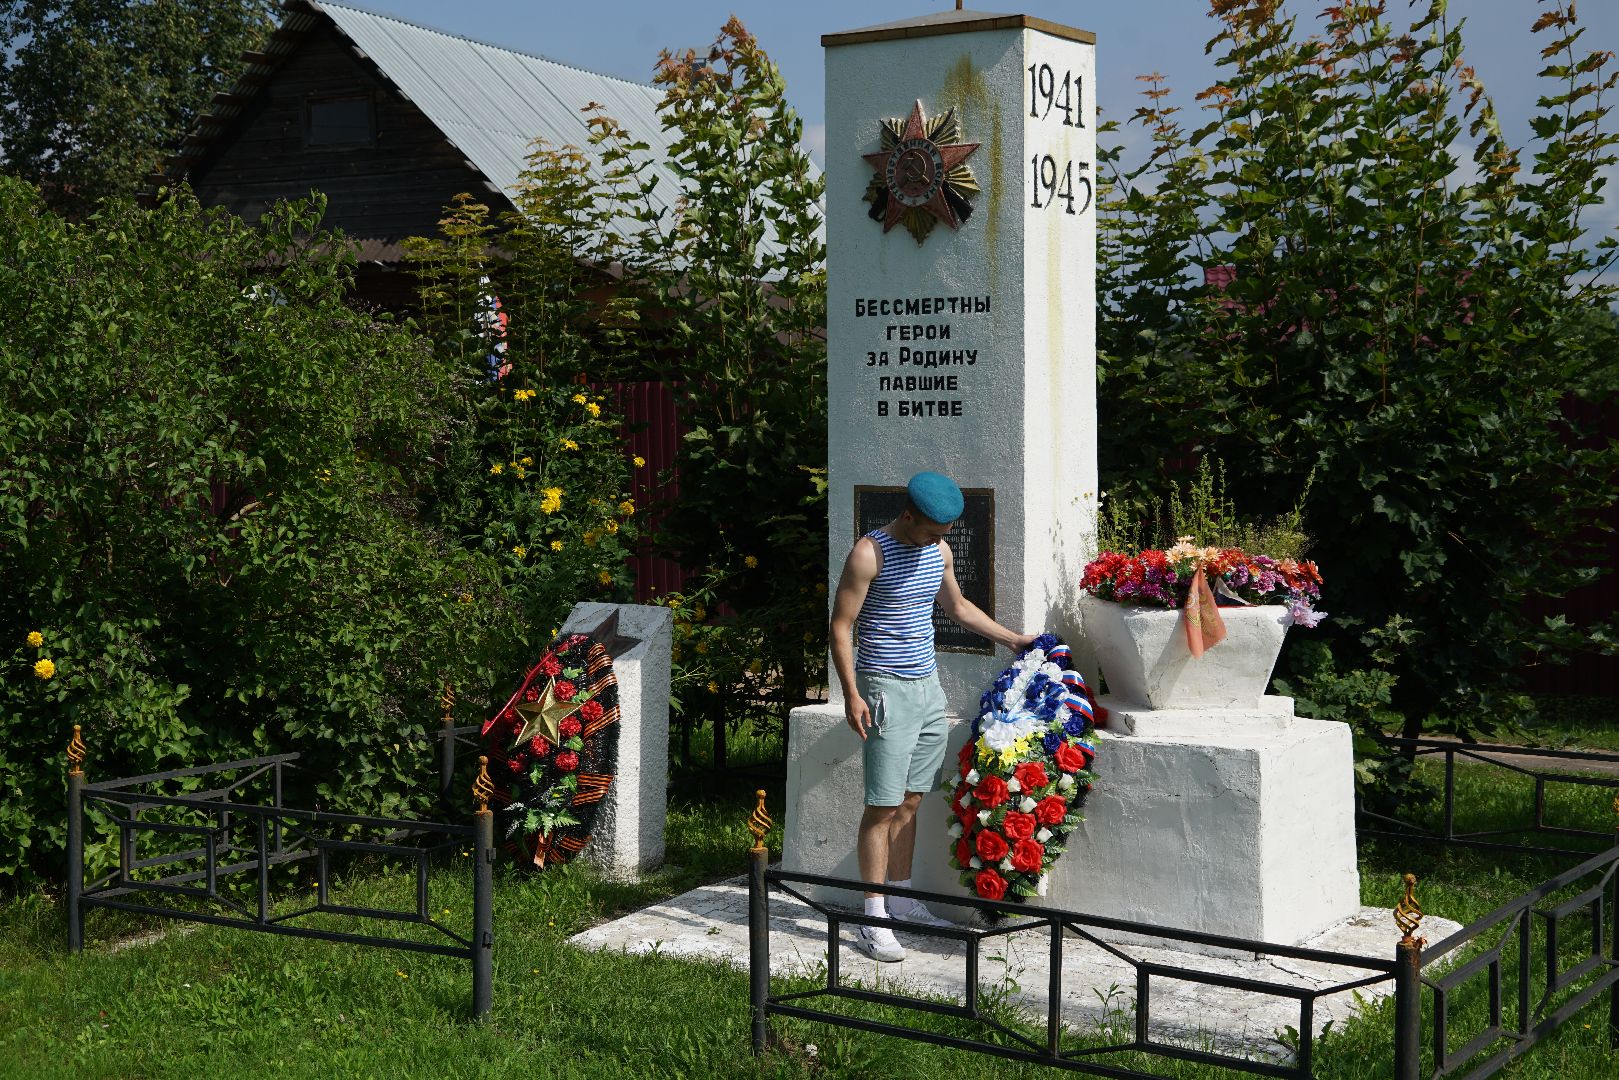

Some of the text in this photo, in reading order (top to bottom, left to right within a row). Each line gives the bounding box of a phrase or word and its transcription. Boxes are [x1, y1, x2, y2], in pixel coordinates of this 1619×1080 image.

[1028, 63, 1085, 128] 1941
[1031, 153, 1092, 216] 1945
[855, 296, 991, 317] БЕССМЕРТНЫ
[886, 325, 951, 341] ГЕРОИ
[866, 351, 889, 367] ЗА
[879, 376, 958, 391] ПАВШИЕ
[877, 400, 963, 417] В БИТВЕ
